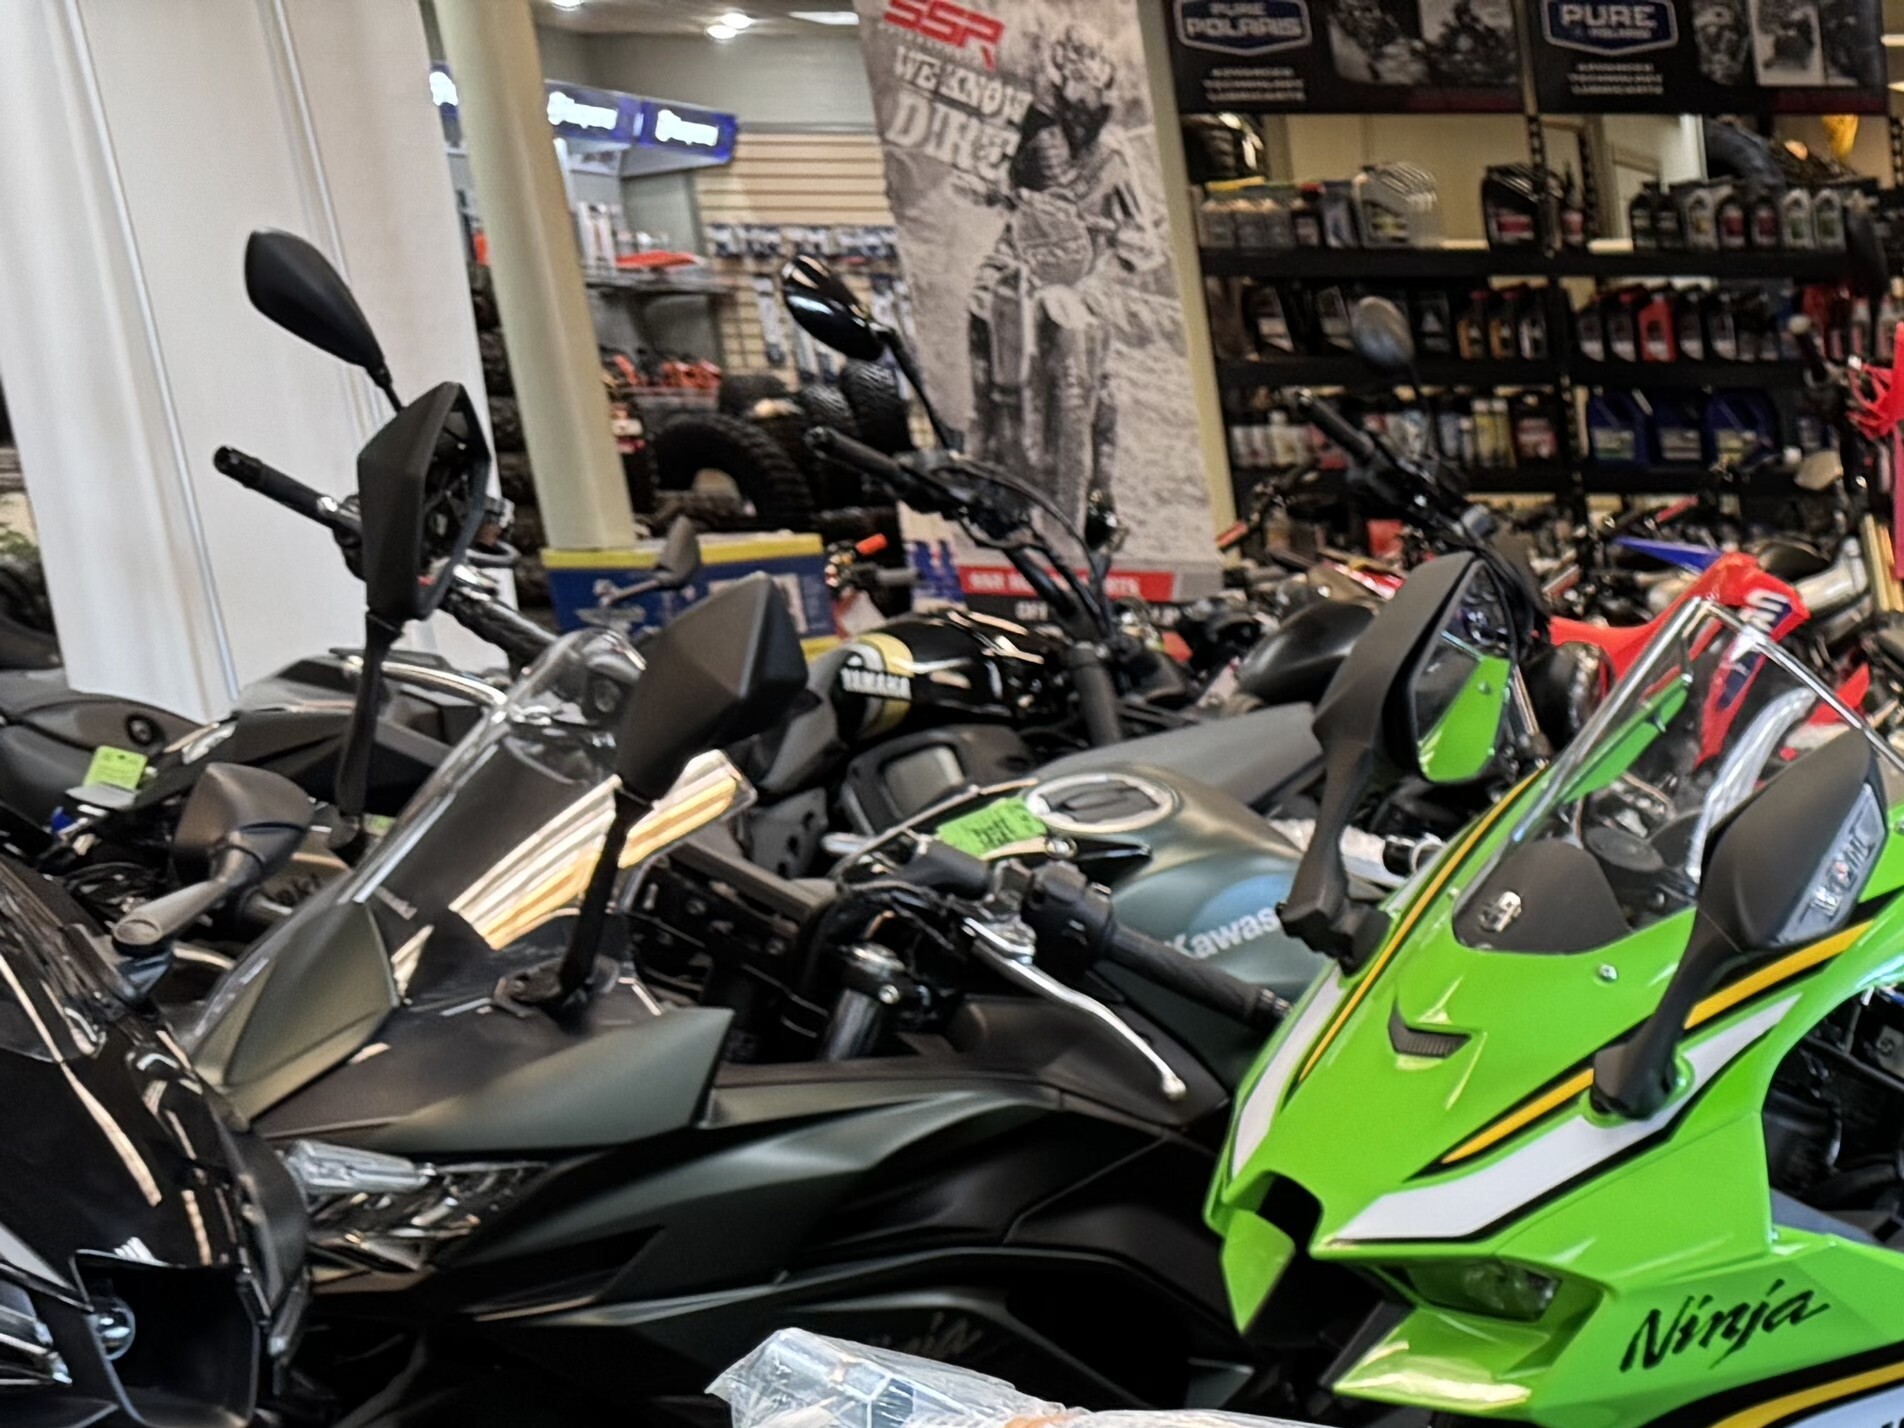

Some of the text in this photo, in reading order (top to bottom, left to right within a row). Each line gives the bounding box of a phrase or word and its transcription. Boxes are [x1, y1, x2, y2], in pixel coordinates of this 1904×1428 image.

[1185, 17, 1302, 37] POLARIS
[1560, 4, 1658, 28] PURE
[895, 46, 942, 92] WE
[885, 90, 1022, 186] DIRT
[840, 667, 912, 700] YAMAHA
[1164, 906, 1280, 958] Kawas
[1618, 1278, 1831, 1374] Ninja
